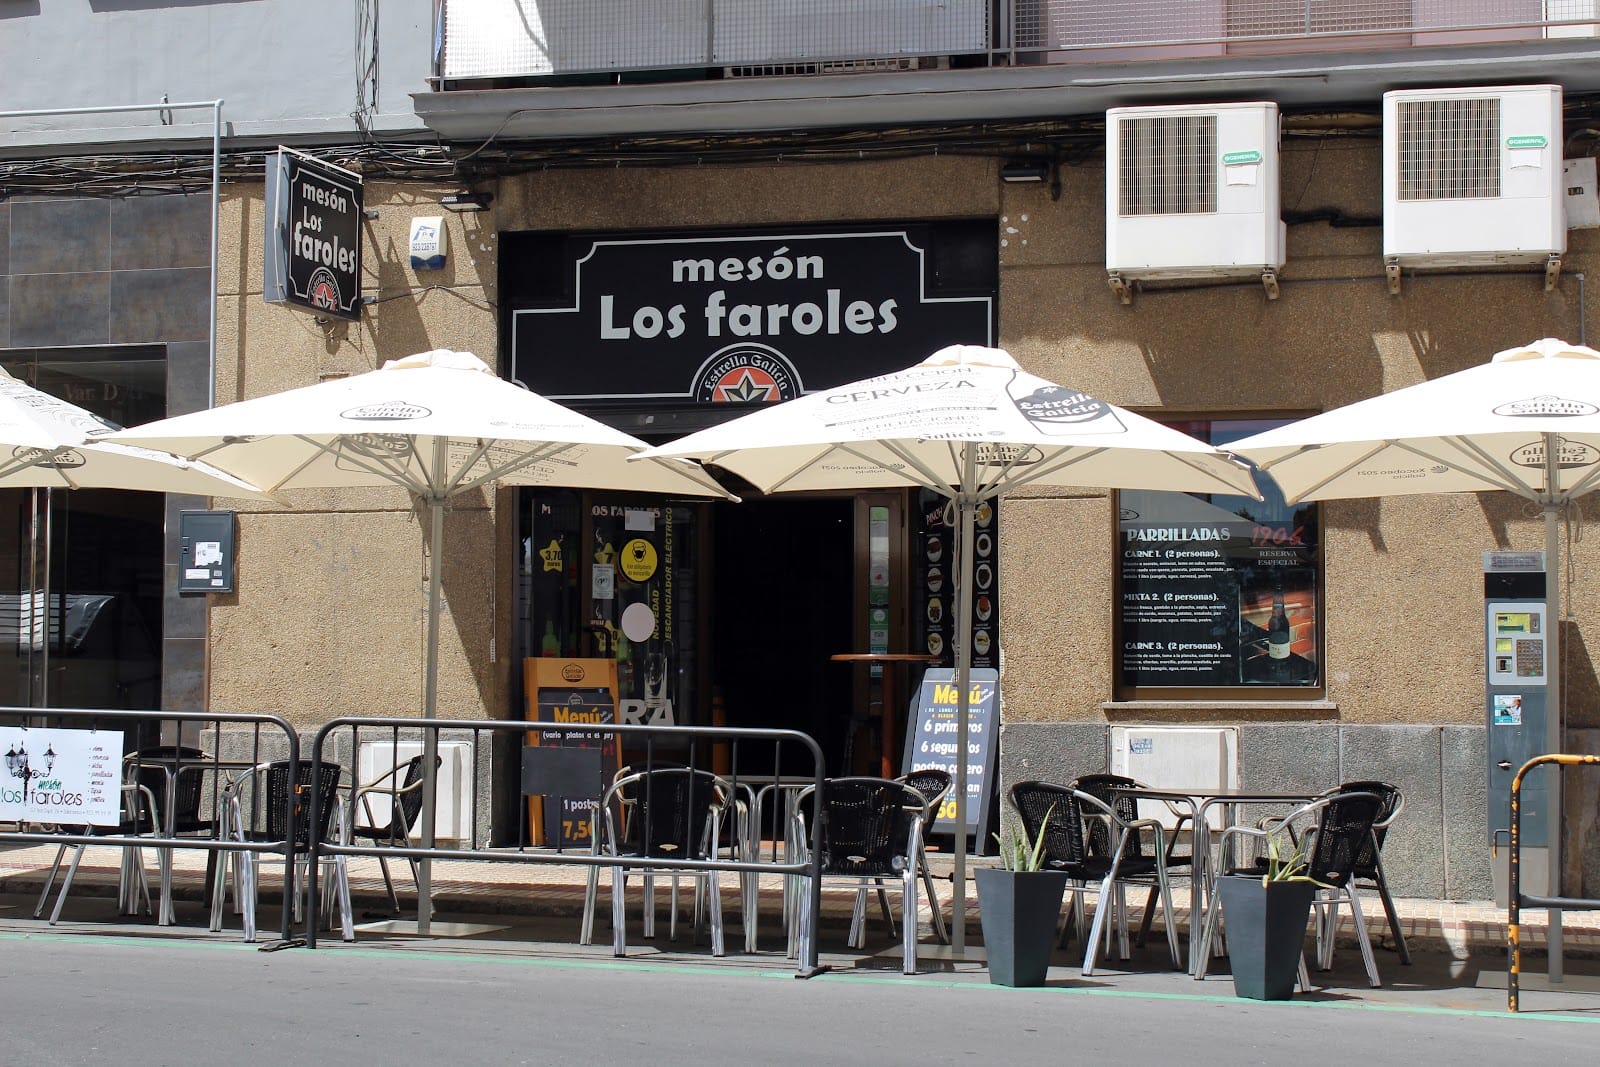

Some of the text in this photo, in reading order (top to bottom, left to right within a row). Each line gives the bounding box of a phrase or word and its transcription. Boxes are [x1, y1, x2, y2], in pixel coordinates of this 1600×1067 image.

[302, 182, 346, 214] mesón
[303, 206, 322, 233] Los
[294, 221, 356, 274] faroles
[671, 246, 825, 283] mesón
[600, 288, 899, 340] Los faroles
[704, 354, 789, 391] Estrella Galicia
[825, 379, 977, 405] CERVEZA
[1027, 402, 1102, 418] Galicia
[1126, 527, 1231, 542] PARRILLADAS
[1251, 525, 1305, 546] 1906
[1124, 550, 1155, 559] CARNE
[1165, 550, 1175, 560] (2
[1175, 550, 1221, 561] personas).
[1259, 550, 1298, 558] RESERVA
[1123, 593, 1151, 601] MIXTA
[1163, 592, 1174, 602] (2
[1174, 592, 1220, 602] personas).
[1124, 642, 1155, 650] CARNE
[1167, 642, 1178, 652] (2
[1178, 642, 1224, 652] personas).
[933, 684, 981, 705] Meú
[553, 705, 601, 724] Menú
[924, 719, 984, 735] 6 primros
[921, 740, 981, 755] 6 seguos
[948, 763, 984, 775] caero
[30, 788, 83, 806] faroles
[563, 799, 569, 810] 1
